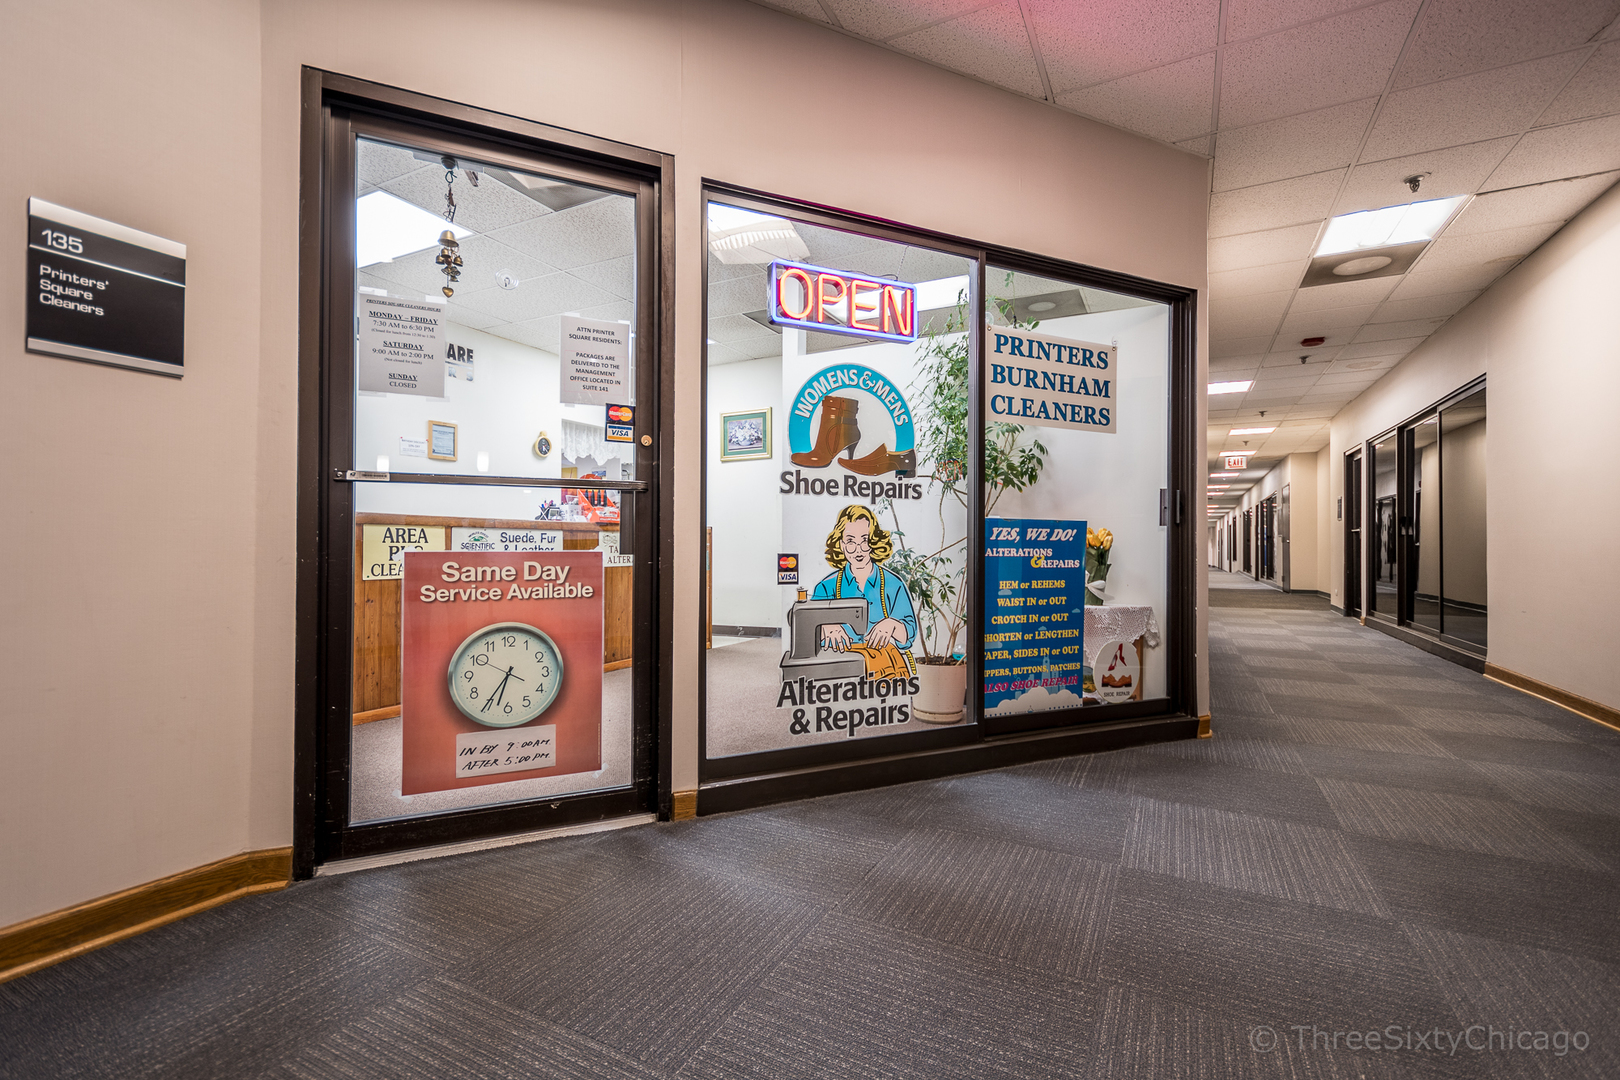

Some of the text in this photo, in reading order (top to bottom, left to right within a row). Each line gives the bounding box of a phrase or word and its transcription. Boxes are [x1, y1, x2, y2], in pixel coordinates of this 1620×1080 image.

[42, 229, 83, 254] 135
[40, 264, 109, 290] Printers'
[40, 278, 93, 300] Square
[40, 292, 105, 316] Cleaners
[779, 267, 913, 336] OPEN
[369, 310, 403, 320] MONDAY
[411, 315, 439, 325] FRIDAY
[569, 333, 591, 341] SQUARE
[576, 326, 615, 336] ATTN PRINTER
[383, 340, 424, 351] SATURDAY
[993, 333, 1109, 370] PRINTERS
[576, 352, 604, 361] PACKAGES
[571, 360, 600, 368] DELIVERED
[388, 373, 417, 381] SUNDAY
[575, 368, 615, 377] MANAGEMENT
[389, 381, 417, 389] CLOSED
[590, 377, 613, 385] LOCATED
[990, 363, 1111, 398] BURNHAM
[794, 369, 909, 426] WOMENS & MENS
[990, 394, 1111, 426] CLEANERS
[611, 429, 629, 437] VISA
[1227, 457, 1244, 467] EXIT
[779, 469, 922, 504] Shoe Repairs
[382, 527, 429, 543] AREA
[540, 532, 556, 543] Fur
[989, 527, 1077, 543] YES, WE DO!
[461, 542, 496, 550] SCIENTIFIC
[985, 548, 1053, 557] ALTERATIONS
[607, 555, 633, 564] ALTER
[1041, 559, 1080, 568] REPAIRS
[441, 561, 570, 584] Same Day
[999, 580, 1019, 589] HEM
[1031, 580, 1066, 589] REHEMS
[420, 582, 594, 602] Service Available
[997, 597, 1025, 607] WAIST
[1027, 597, 1037, 606] IN
[1049, 596, 1067, 605] OUT
[991, 614, 1027, 624] CROTCH
[1029, 614, 1039, 623] IN
[1051, 612, 1069, 621] OUT
[1035, 629, 1079, 639] LENGTHEN
[484, 640, 495, 652] 11
[501, 636, 516, 648] 12
[523, 640, 529, 651] 1
[534, 651, 544, 663] 2
[984, 650, 1012, 660] APER,
[1013, 648, 1038, 658] SIDES
[1040, 647, 1050, 656] IN
[1062, 645, 1079, 654] OUT
[470, 653, 489, 666] 10
[541, 666, 550, 677] 3
[1013, 665, 1048, 675] BUTTONS,
[1050, 662, 1080, 671] PATCHES
[464, 670, 474, 683] 9
[535, 682, 544, 693] 4
[776, 672, 920, 707] Alterations
[984, 676, 1078, 693] ALSO SHOE REPAIR
[469, 686, 479, 699] 8
[503, 701, 513, 714] 6
[522, 695, 531, 708] 5
[789, 699, 910, 737] & Repairs
[459, 746, 477, 756] IN
[480, 744, 499, 755] BY
[462, 758, 499, 771] AFTER
